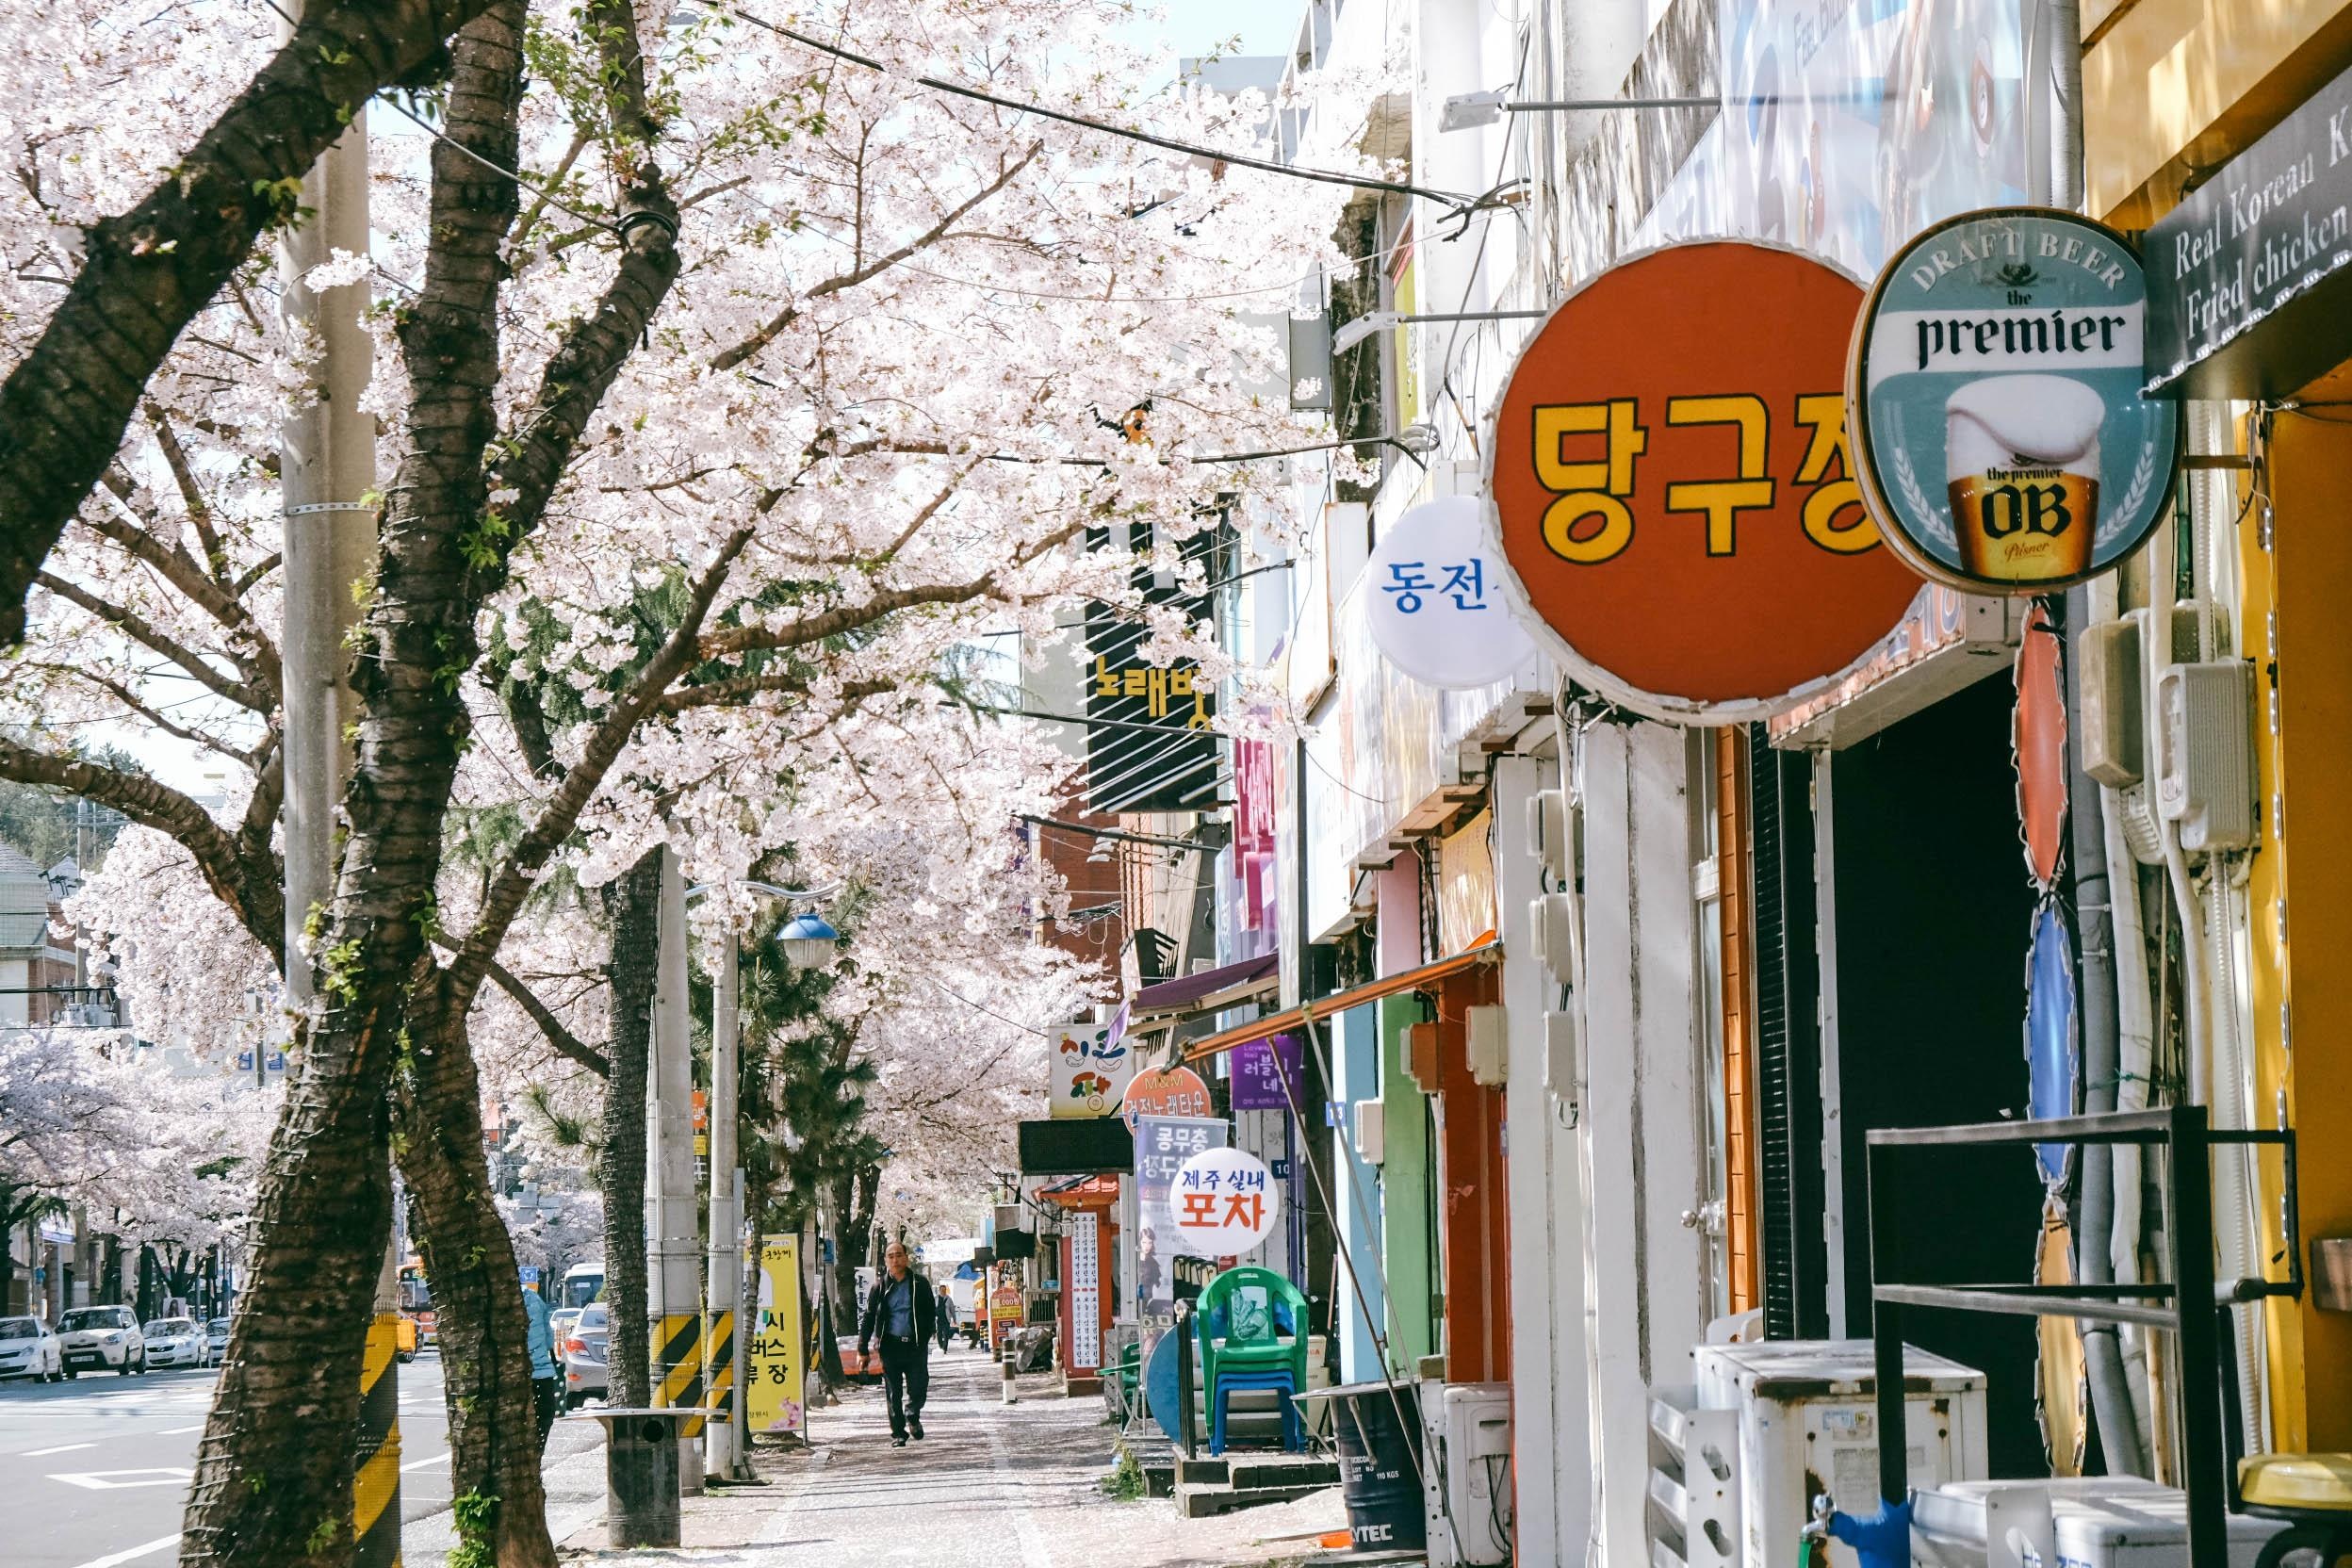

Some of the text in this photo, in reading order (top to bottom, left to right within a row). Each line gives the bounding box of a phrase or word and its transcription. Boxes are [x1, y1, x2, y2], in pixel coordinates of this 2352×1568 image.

[2175, 105, 2352, 282] Real Korean K
[1911, 232, 2127, 294] DRAFT BEER
[2186, 204, 2349, 342] Fried chicken
[2007, 289, 2034, 307] the
[1916, 309, 2127, 371] premier
[1986, 466, 2065, 483] the premier
[1981, 482, 2072, 541] OB
[2003, 541, 2050, 564] Pilsner
[1380, 558, 1499, 614] 동전
[1095, 654, 1214, 740] 노래방
[1144, 1072, 1184, 1090] M&M
[1329, 1105, 1344, 1120] 13
[1182, 1168, 1266, 1192] 제주 실내
[1179, 1192, 1266, 1233] 포차
[766, 1311, 785, 1331] 시
[751, 1337, 787, 1359] 버스
[748, 1363, 789, 1385] 류장
[1376, 1472, 1386, 1480] 110
[1386, 1470, 1399, 1478] KGS
[1349, 1523, 1394, 1544] YTEC
